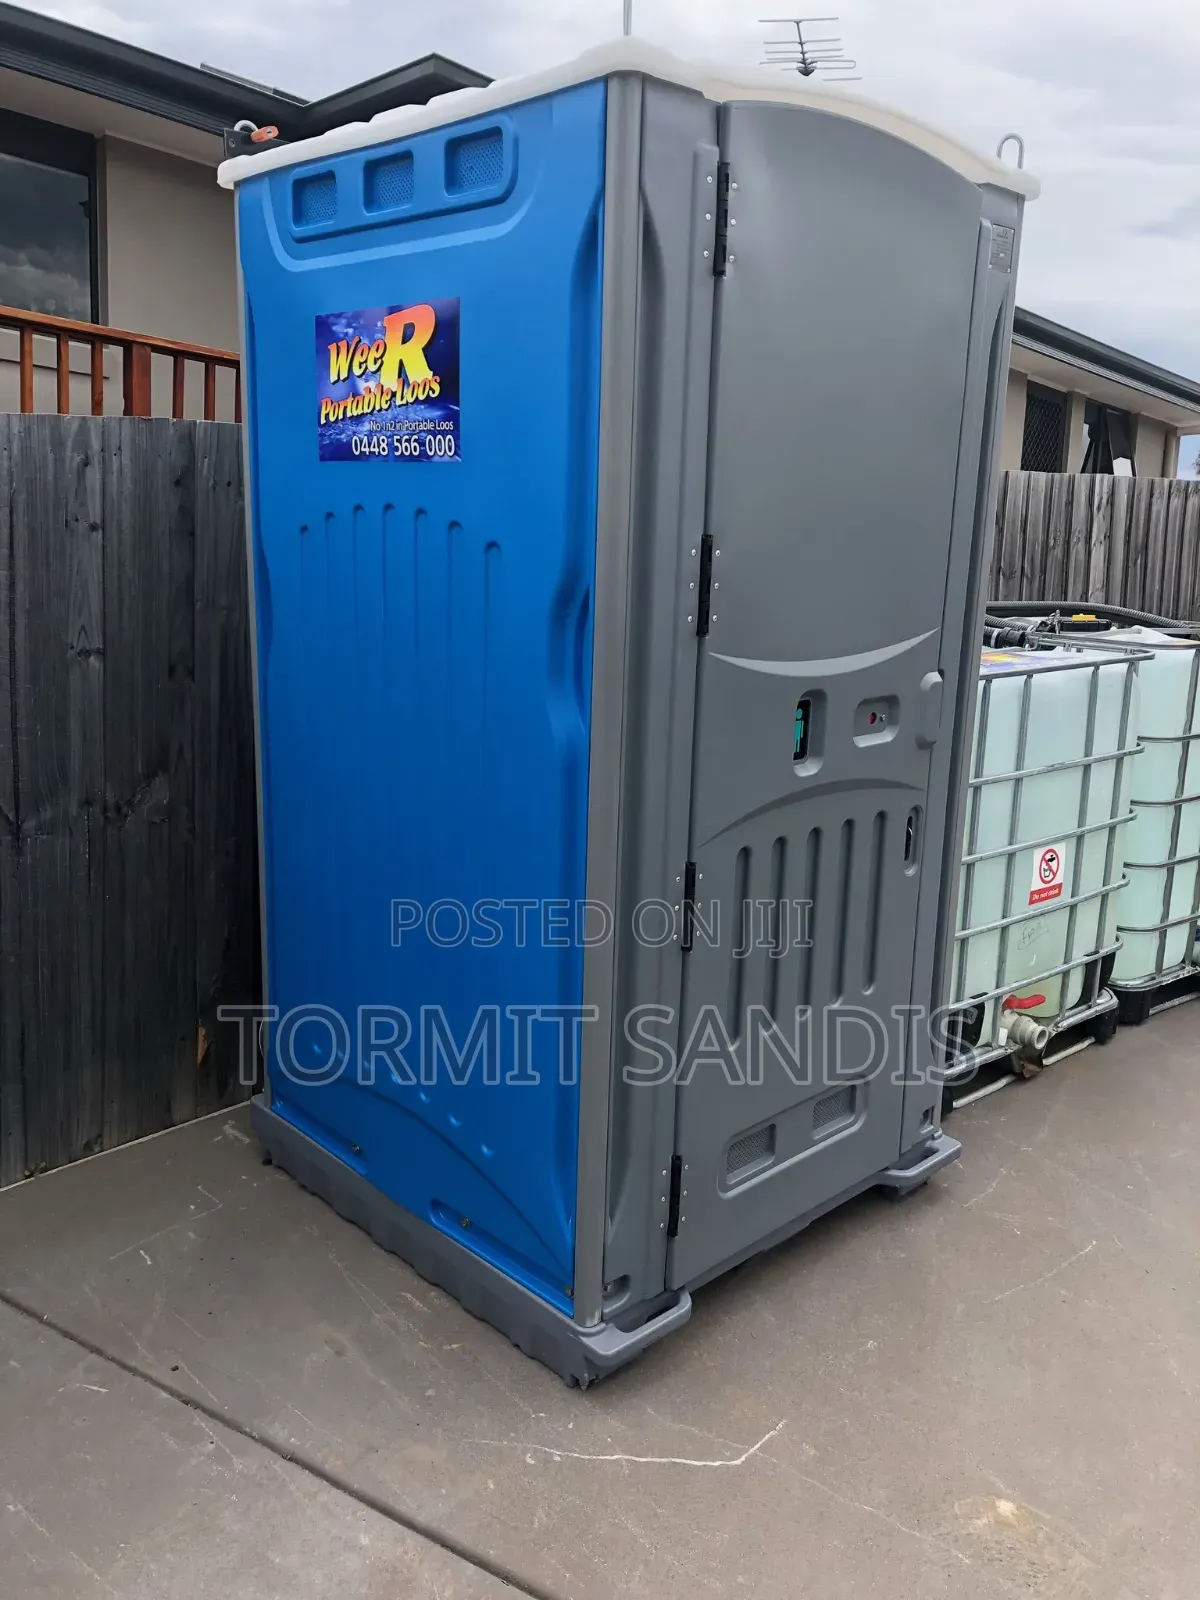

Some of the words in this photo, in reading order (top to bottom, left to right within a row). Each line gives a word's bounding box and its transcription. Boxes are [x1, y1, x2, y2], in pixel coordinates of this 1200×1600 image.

[328, 336, 386, 385] Wee
[380, 304, 436, 392] R
[320, 383, 392, 425] Portable
[396, 375, 440, 406] Loos
[396, 420, 404, 430] in
[404, 418, 434, 430] Portable
[435, 419, 454, 430] Loos
[352, 435, 388, 456] 0448
